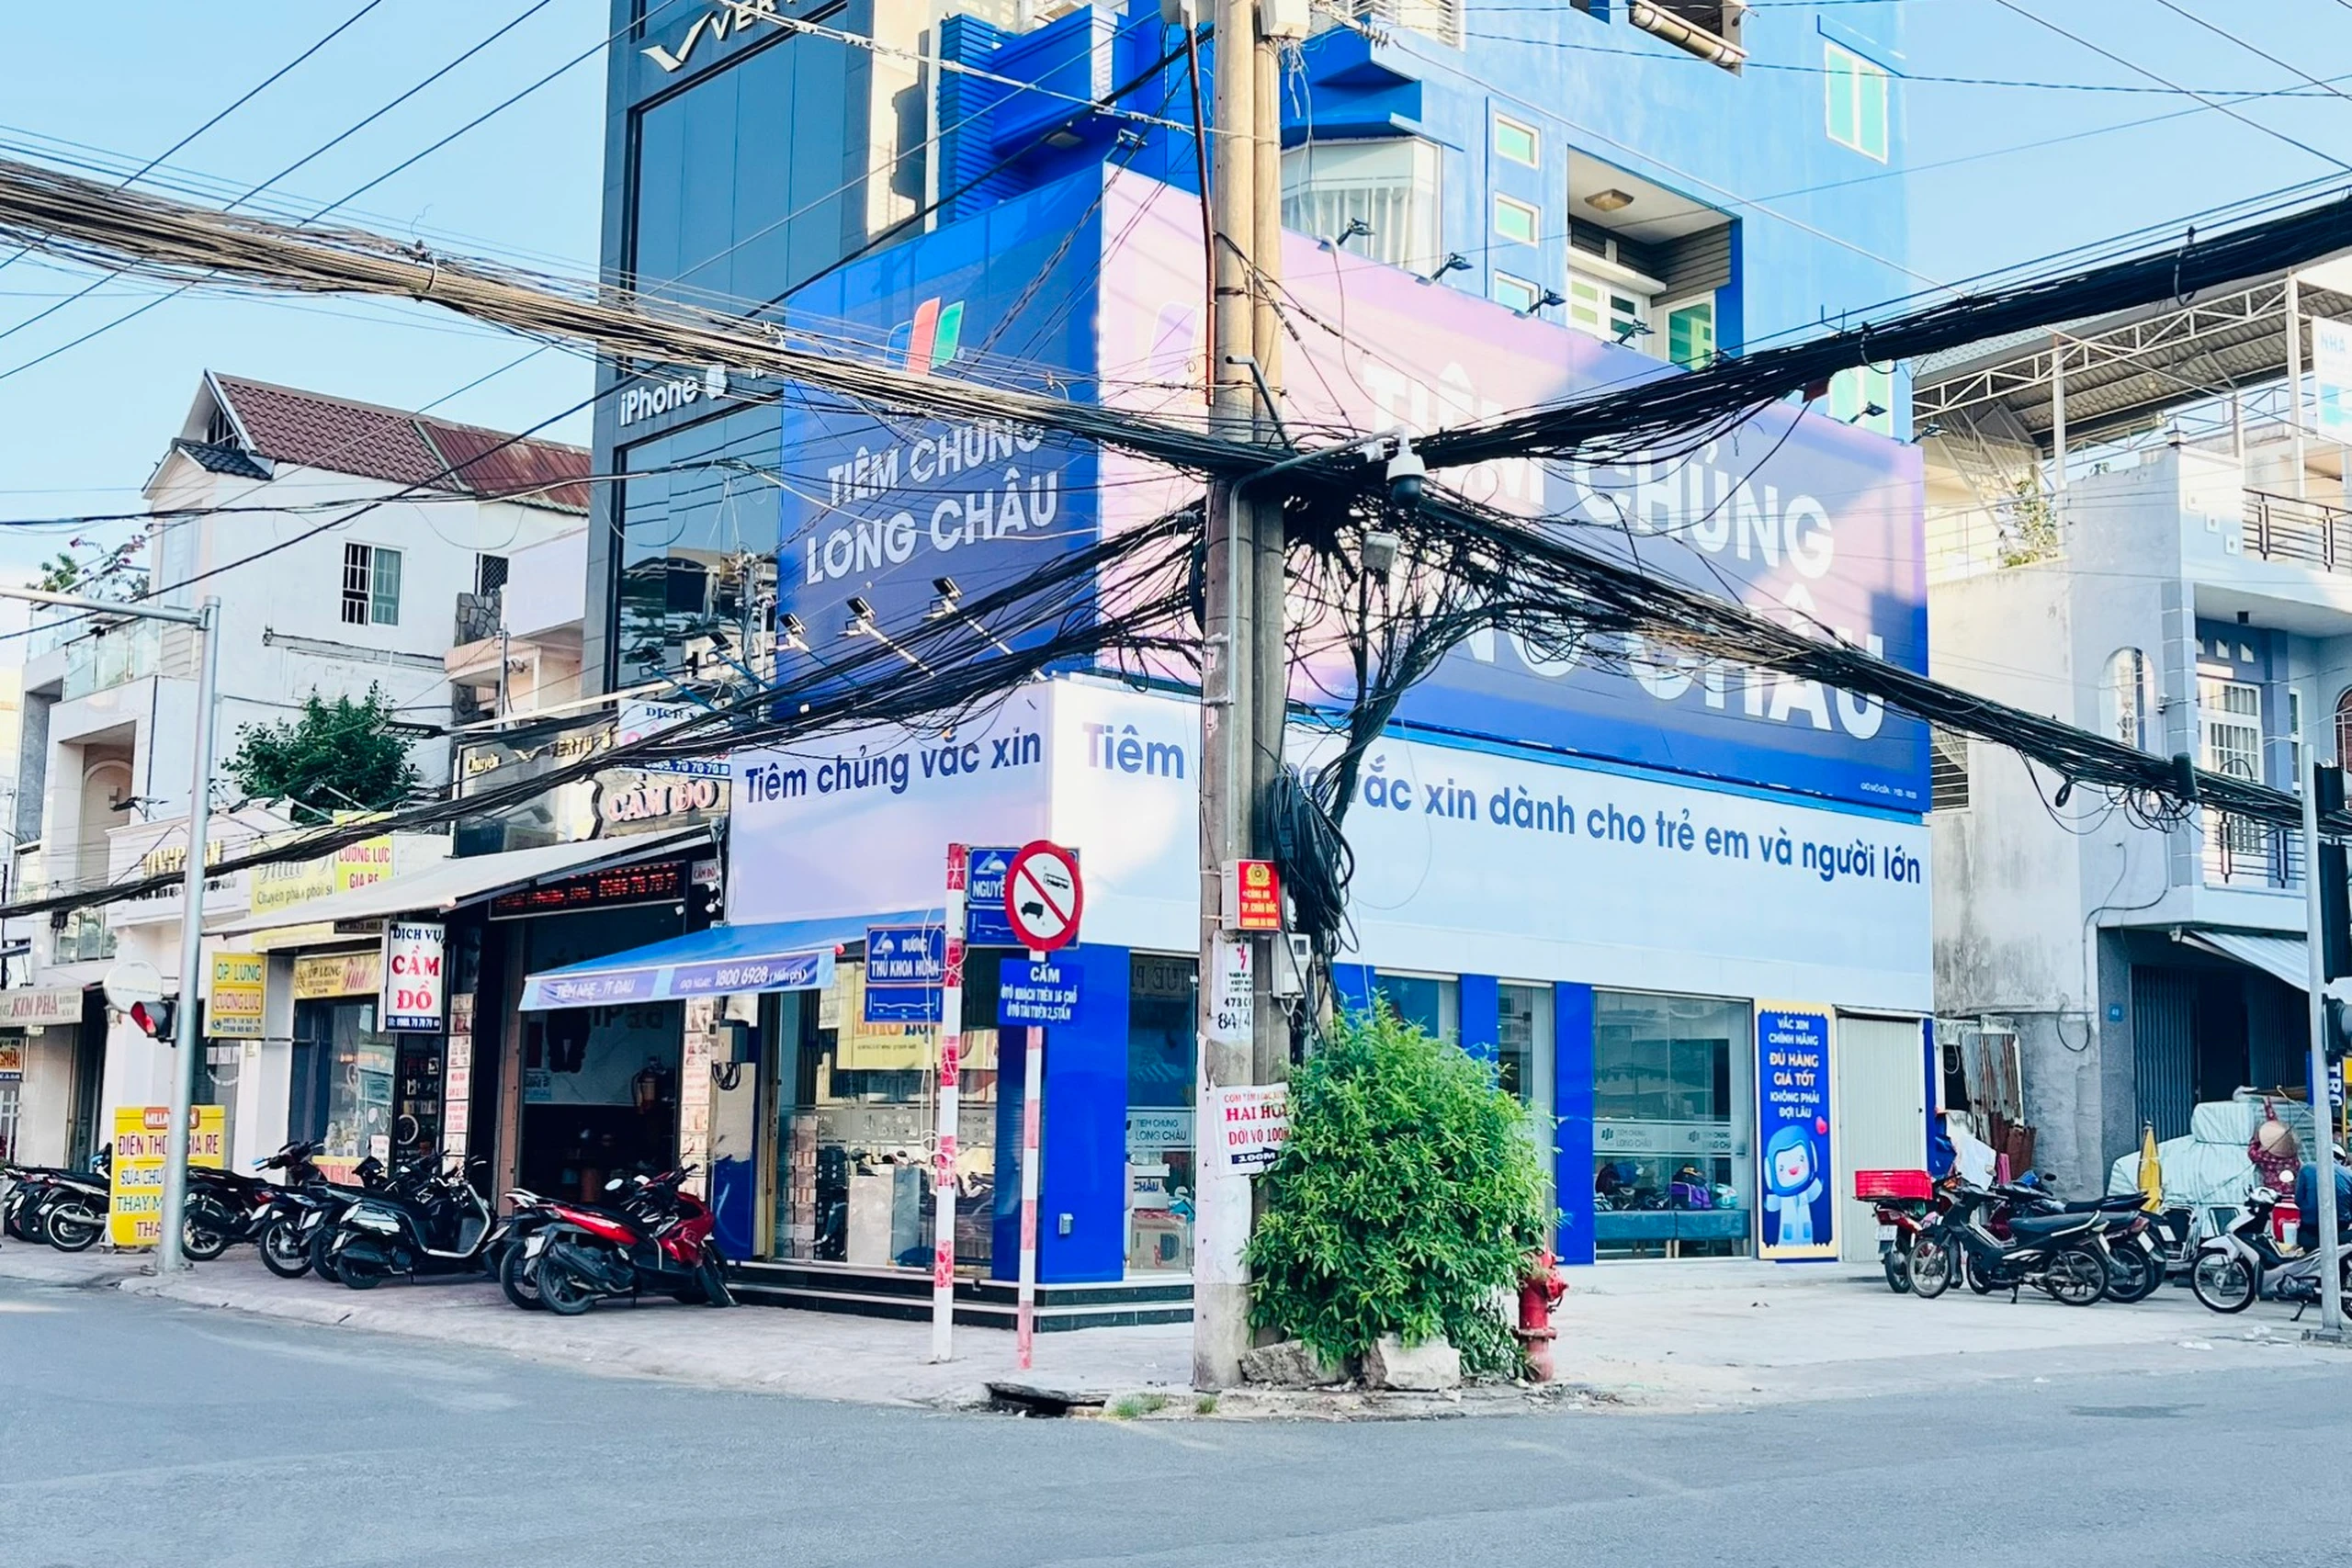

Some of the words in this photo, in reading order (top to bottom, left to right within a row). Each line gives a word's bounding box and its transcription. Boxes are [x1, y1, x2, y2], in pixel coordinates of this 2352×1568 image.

[620, 375, 698, 427] iPhone
[827, 446, 899, 507] TIÊM
[1574, 439, 1835, 581] CHỦNG
[805, 511, 917, 585] LONG
[931, 466, 1059, 552] CHÂU
[745, 762, 807, 803] Tiêm
[817, 745, 910, 795] chủng
[922, 729, 981, 778] vắc
[992, 727, 1042, 768] xin
[1082, 722, 1184, 780] Tiêm
[1424, 779, 1476, 821] xin
[1489, 784, 1575, 836] dành
[1587, 799, 1645, 845] cho
[1656, 807, 1695, 852] trẻ
[1704, 827, 1748, 860] em
[1758, 826, 1792, 866] và
[1803, 838, 1876, 883] người
[1883, 844, 1922, 886] lớn
[973, 874, 1005, 898] NGUYỄ
[394, 928, 421, 942] DỊCH
[425, 929, 441, 943] VỤ
[391, 944, 440, 976] CẦM
[871, 956, 888, 977] THỦ
[889, 960, 913, 977] KHOA
[715, 968, 739, 987] 1800
[741, 965, 769, 985] 6928
[1030, 963, 1060, 983] CẤM
[396, 980, 433, 1010] ĐỒ
[1769, 1047, 1786, 1066] ĐỦ
[1788, 1049, 1819, 1068] HÀNG
[1773, 1068, 1793, 1086] GIÁ
[1794, 1068, 1815, 1087] TỐT
[1770, 1089, 1799, 1103] KHÔNG
[1800, 1089, 1820, 1104] PHẢI
[1226, 1106, 1256, 1122] HAI
[1795, 1105, 1812, 1119] LÂU
[1238, 1152, 1276, 1163] 100M
[117, 1196, 151, 1212] THAY
